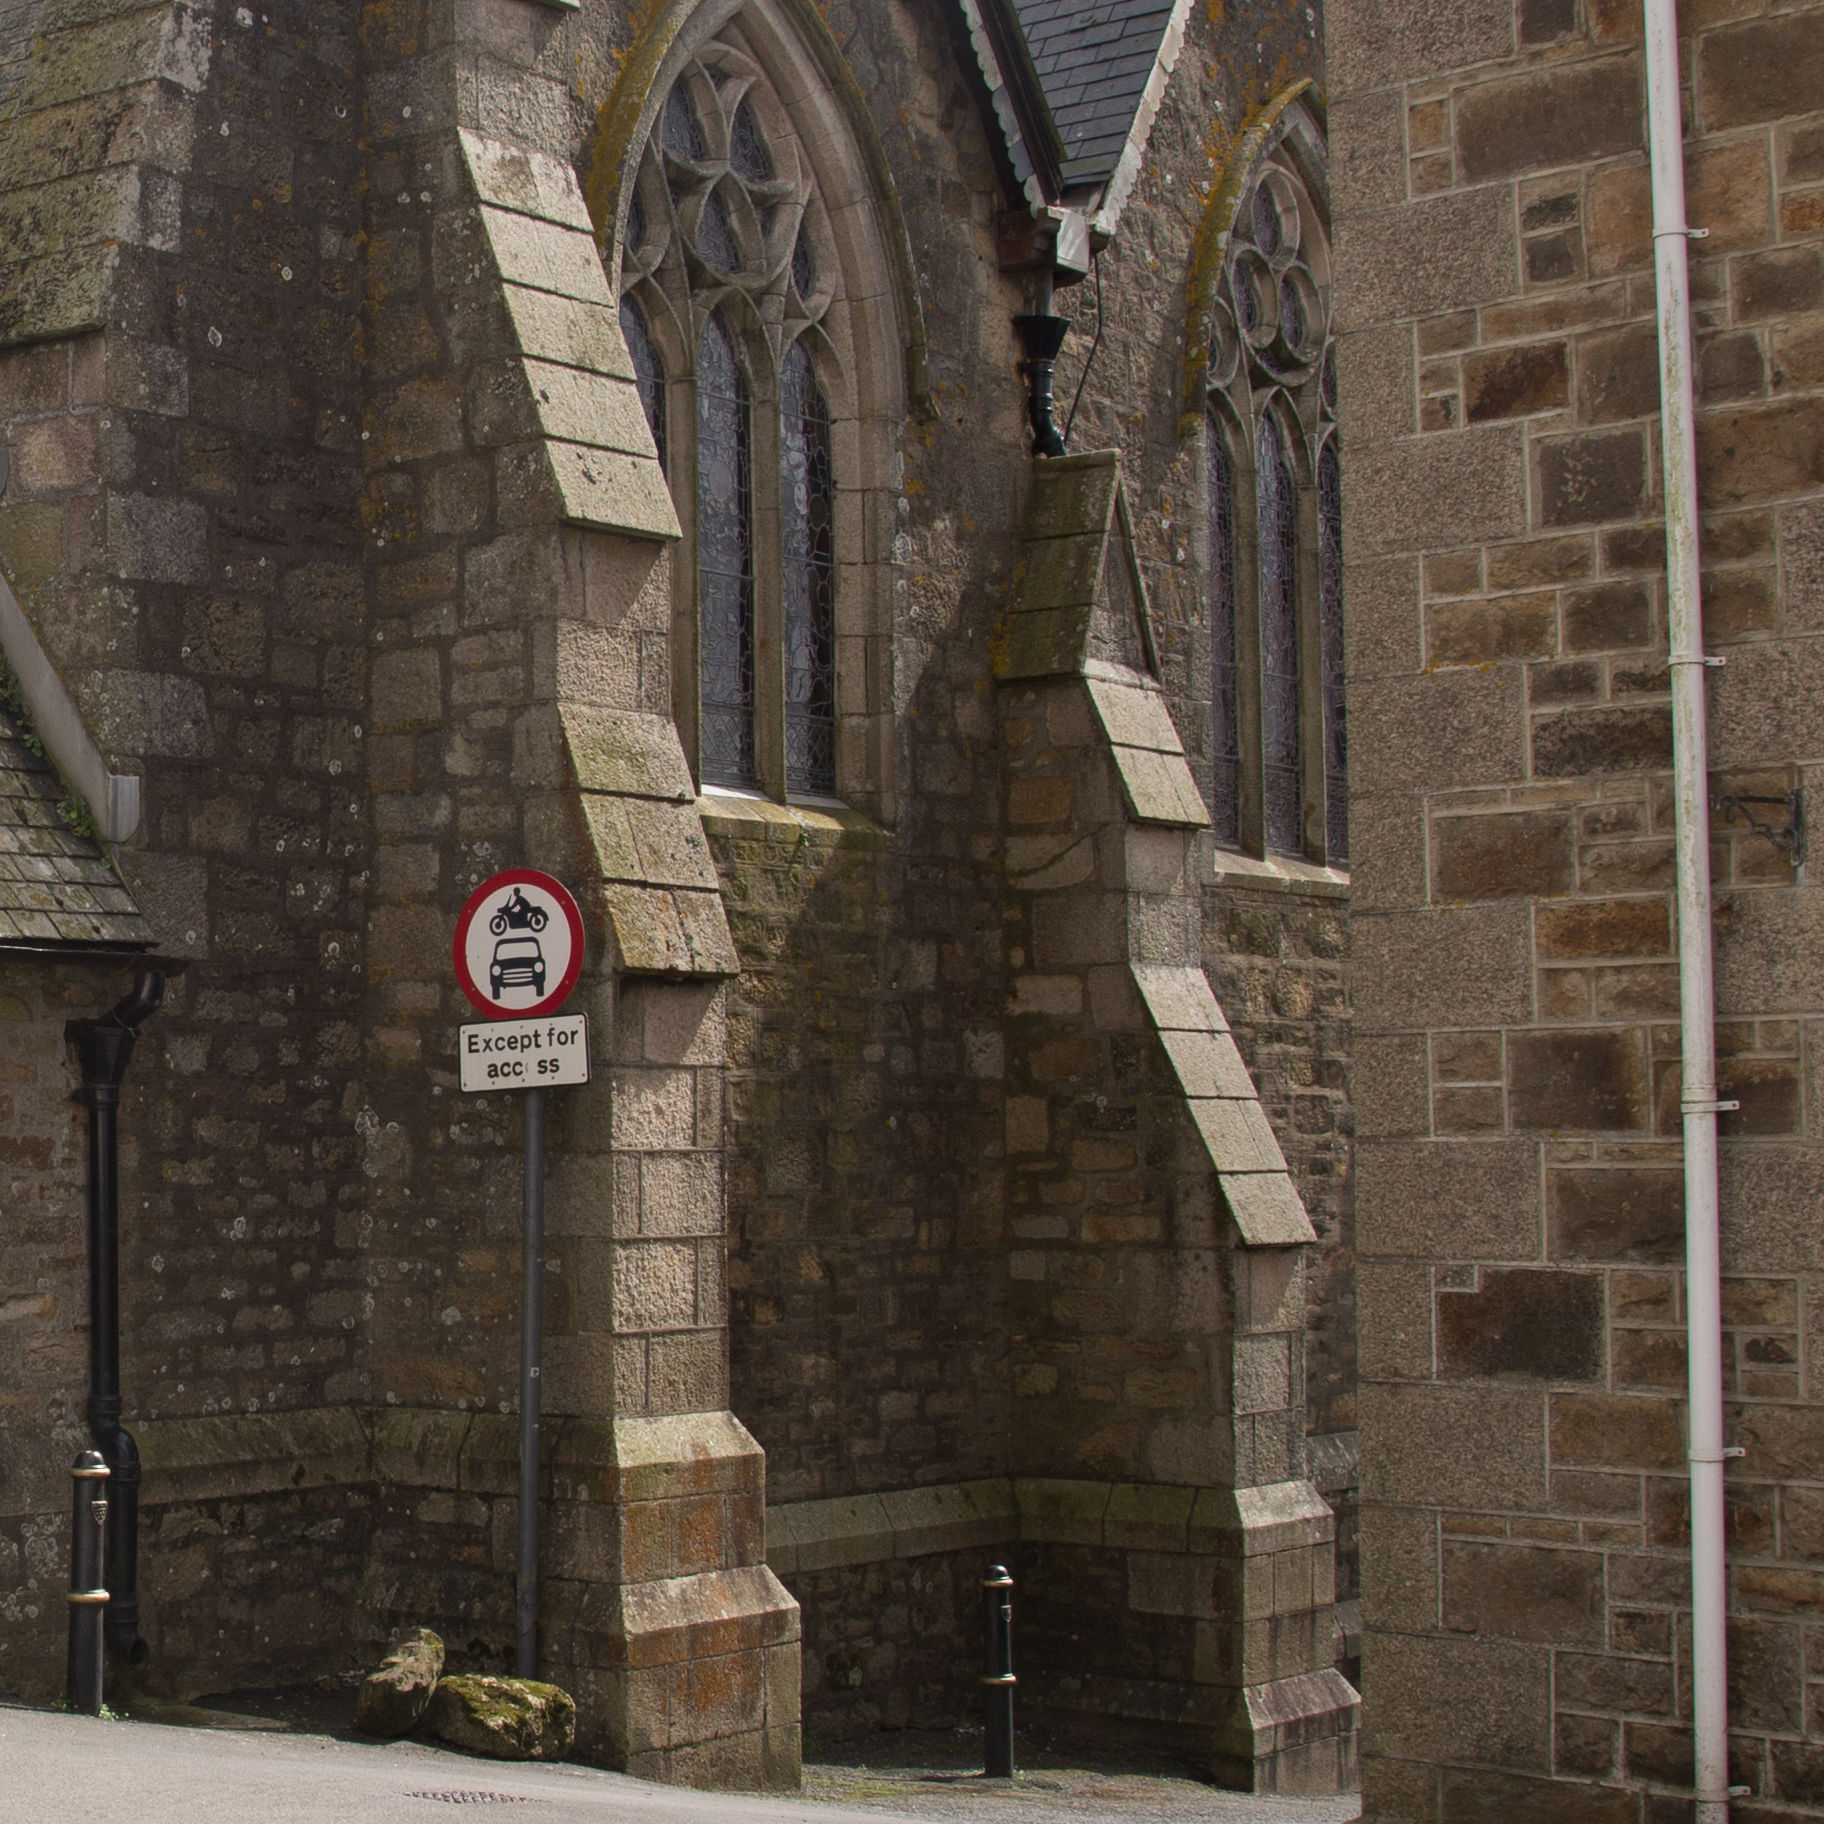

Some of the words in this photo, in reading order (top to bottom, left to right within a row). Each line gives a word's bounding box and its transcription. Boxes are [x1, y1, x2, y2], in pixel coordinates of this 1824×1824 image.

[467, 1028, 542, 1054] Except
[547, 1027, 579, 1048] for
[487, 1057, 560, 1079] accss
